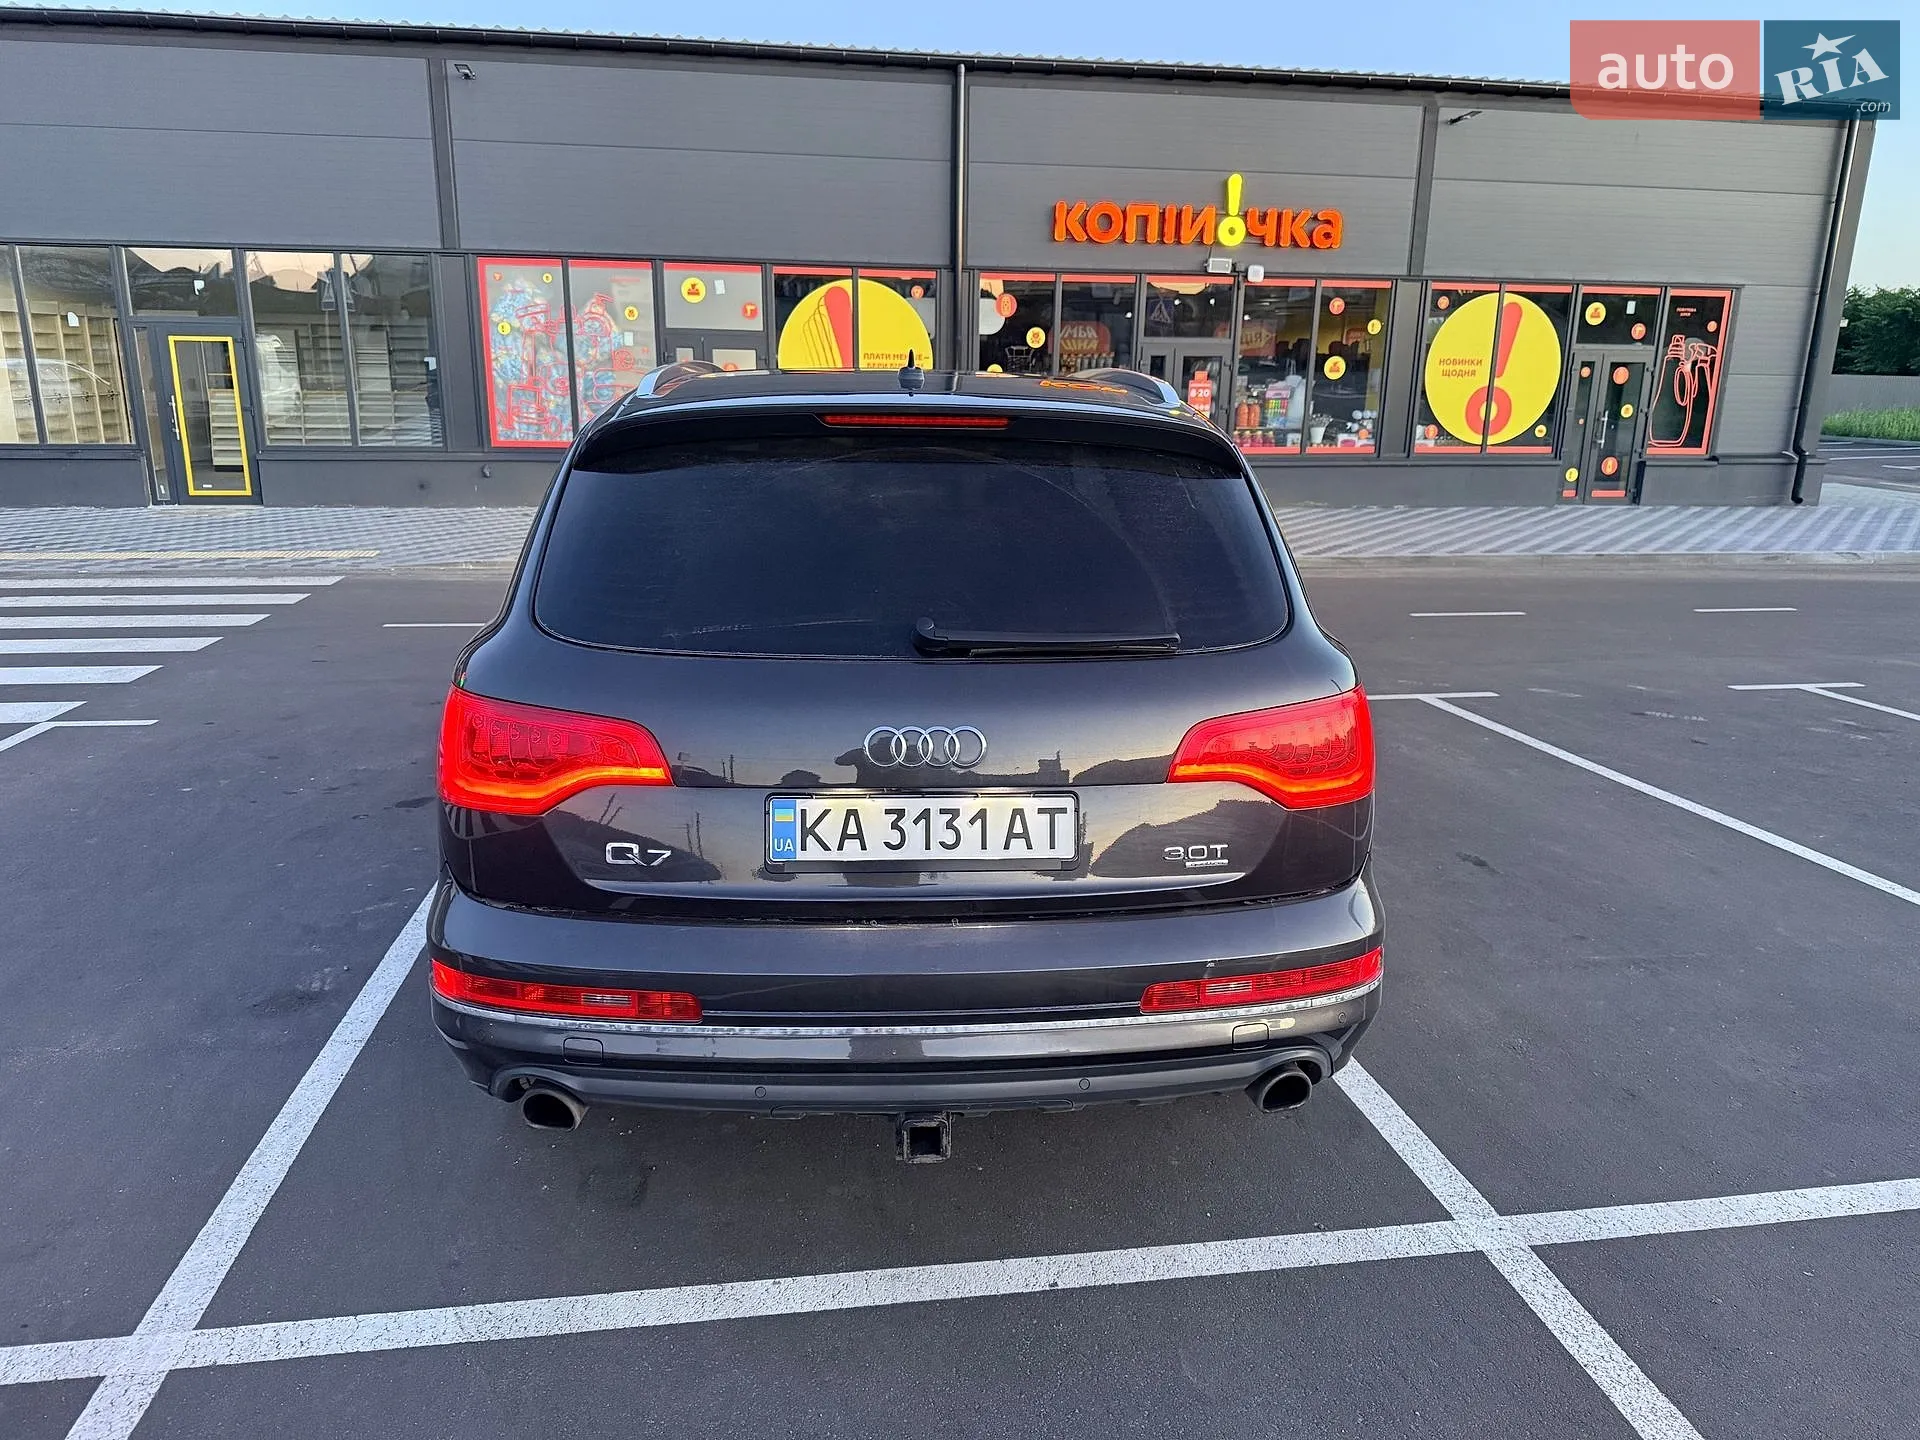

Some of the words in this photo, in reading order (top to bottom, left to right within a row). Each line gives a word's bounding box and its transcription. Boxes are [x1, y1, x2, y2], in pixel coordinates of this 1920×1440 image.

[1441, 369, 1477, 378] ЩОДНЯ
[800, 807, 868, 852] KA
[882, 807, 988, 851] 3131
[1003, 807, 1068, 851] AT
[605, 842, 672, 866] Q7
[774, 838, 794, 852] UA
